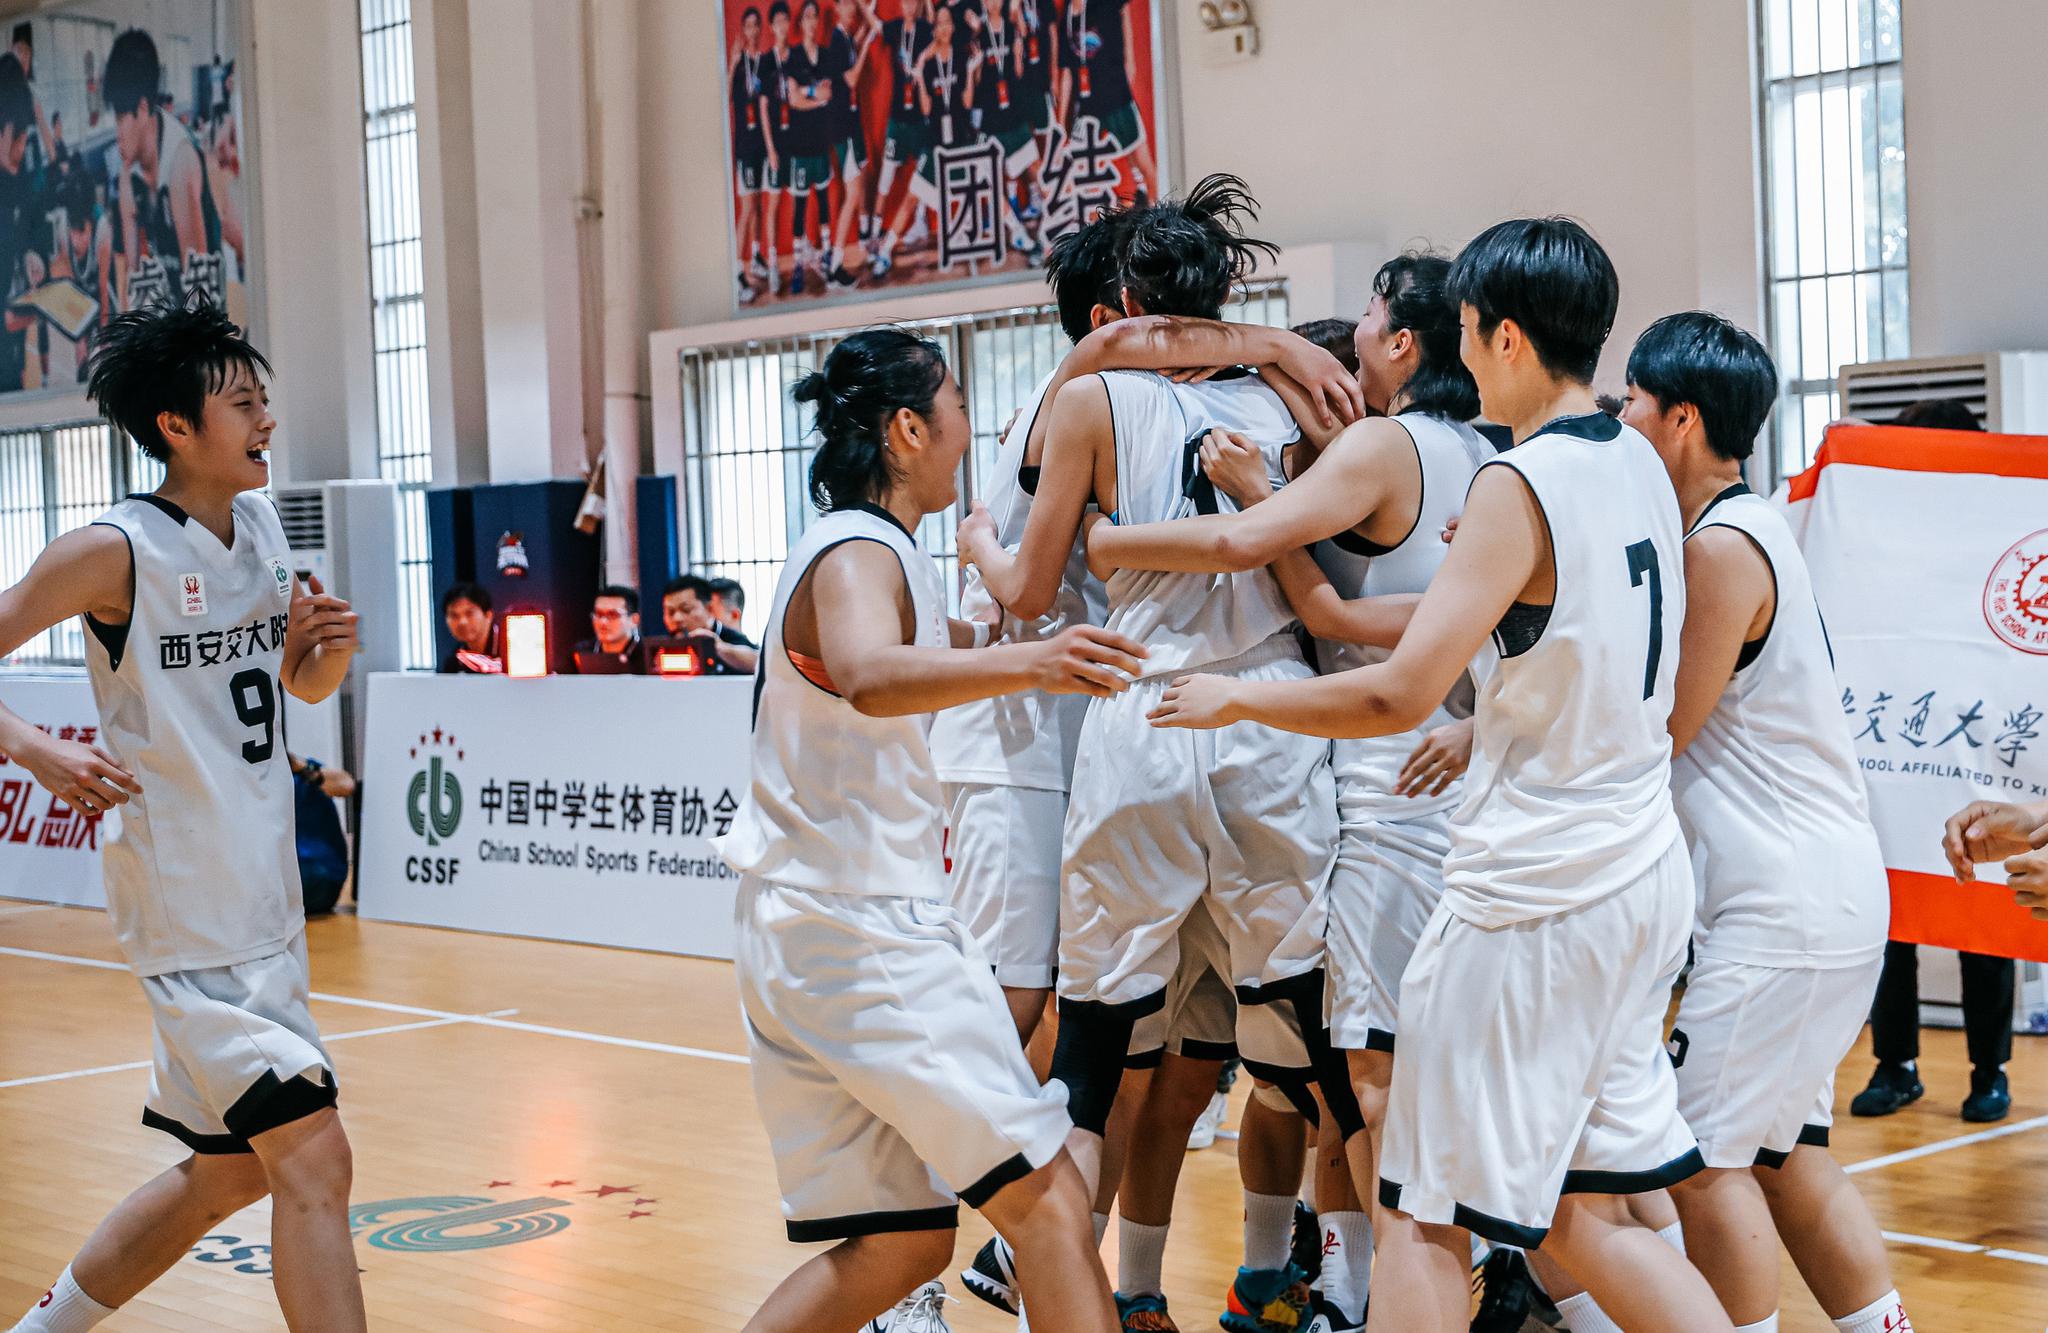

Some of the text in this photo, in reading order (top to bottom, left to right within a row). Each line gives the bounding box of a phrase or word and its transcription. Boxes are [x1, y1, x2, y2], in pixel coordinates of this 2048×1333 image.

[934, 119, 1119, 267] 团结
[1625, 537, 1663, 701] 7
[229, 667, 275, 765] 9
[1900, 761, 1993, 786] AFFILIATED
[2001, 776, 2024, 790] TO
[480, 777, 739, 838] 中国中学生体育协会
[406, 856, 460, 884] CSSF
[478, 838, 521, 863] China
[527, 841, 579, 868] School
[585, 845, 638, 875] Sports
